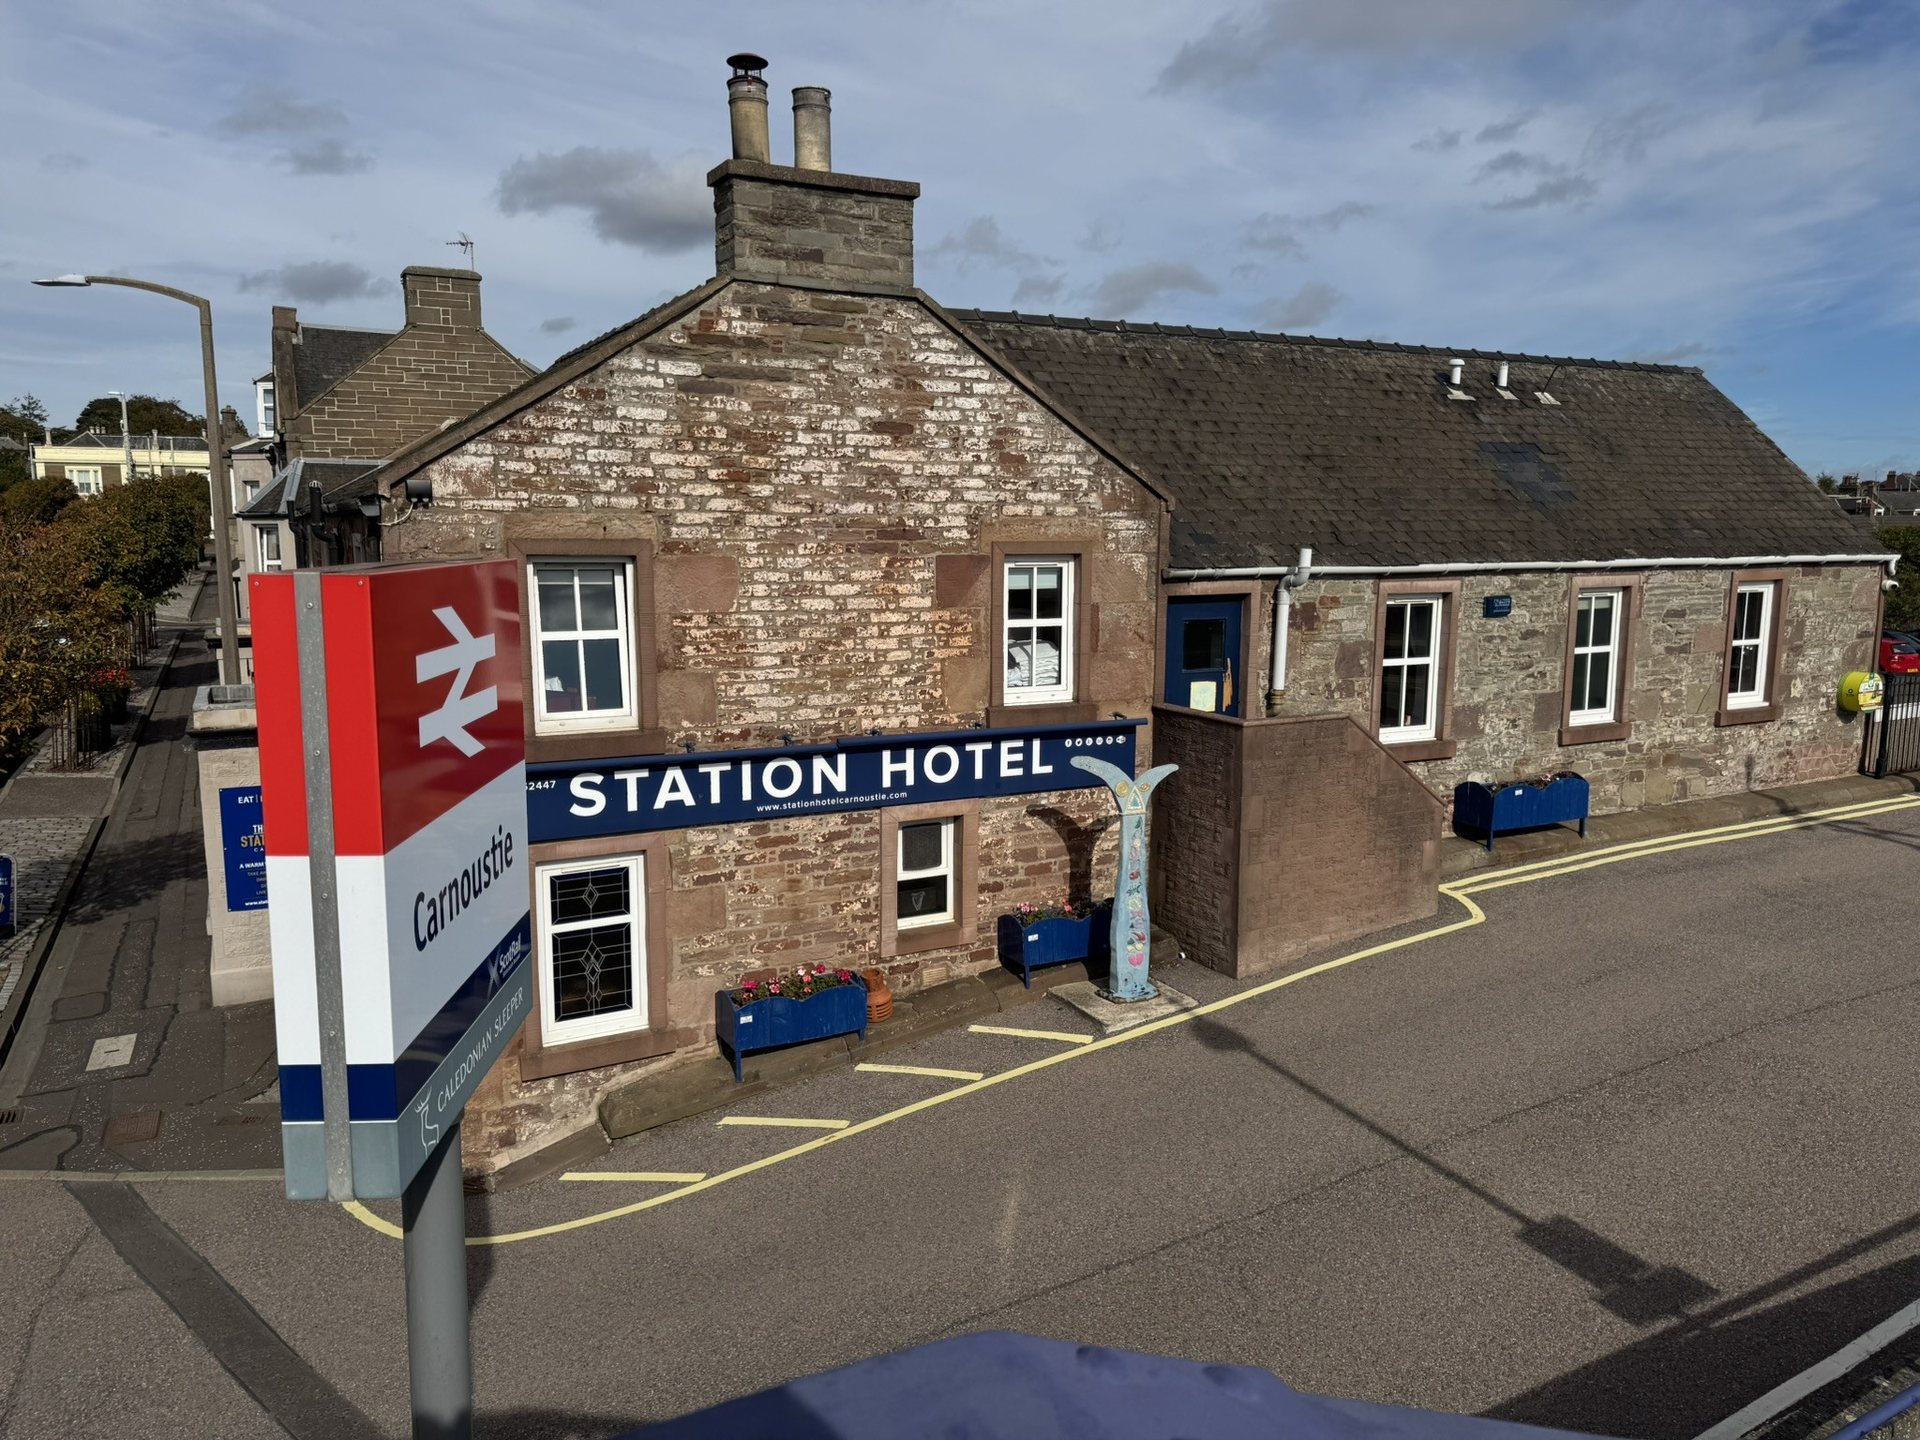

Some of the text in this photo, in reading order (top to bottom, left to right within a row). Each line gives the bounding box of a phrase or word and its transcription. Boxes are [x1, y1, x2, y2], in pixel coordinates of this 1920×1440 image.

[238, 796, 254, 804] EAT
[569, 738, 1053, 817] STATION HOTEL
[756, 792, 908, 812] www.stationhotelcarnoustie.com
[413, 824, 513, 952] Carnoustie
[499, 932, 521, 973] ScotRail
[437, 1027, 492, 1112] CALEDONIAN
[494, 987, 523, 1037] SLEEPER
